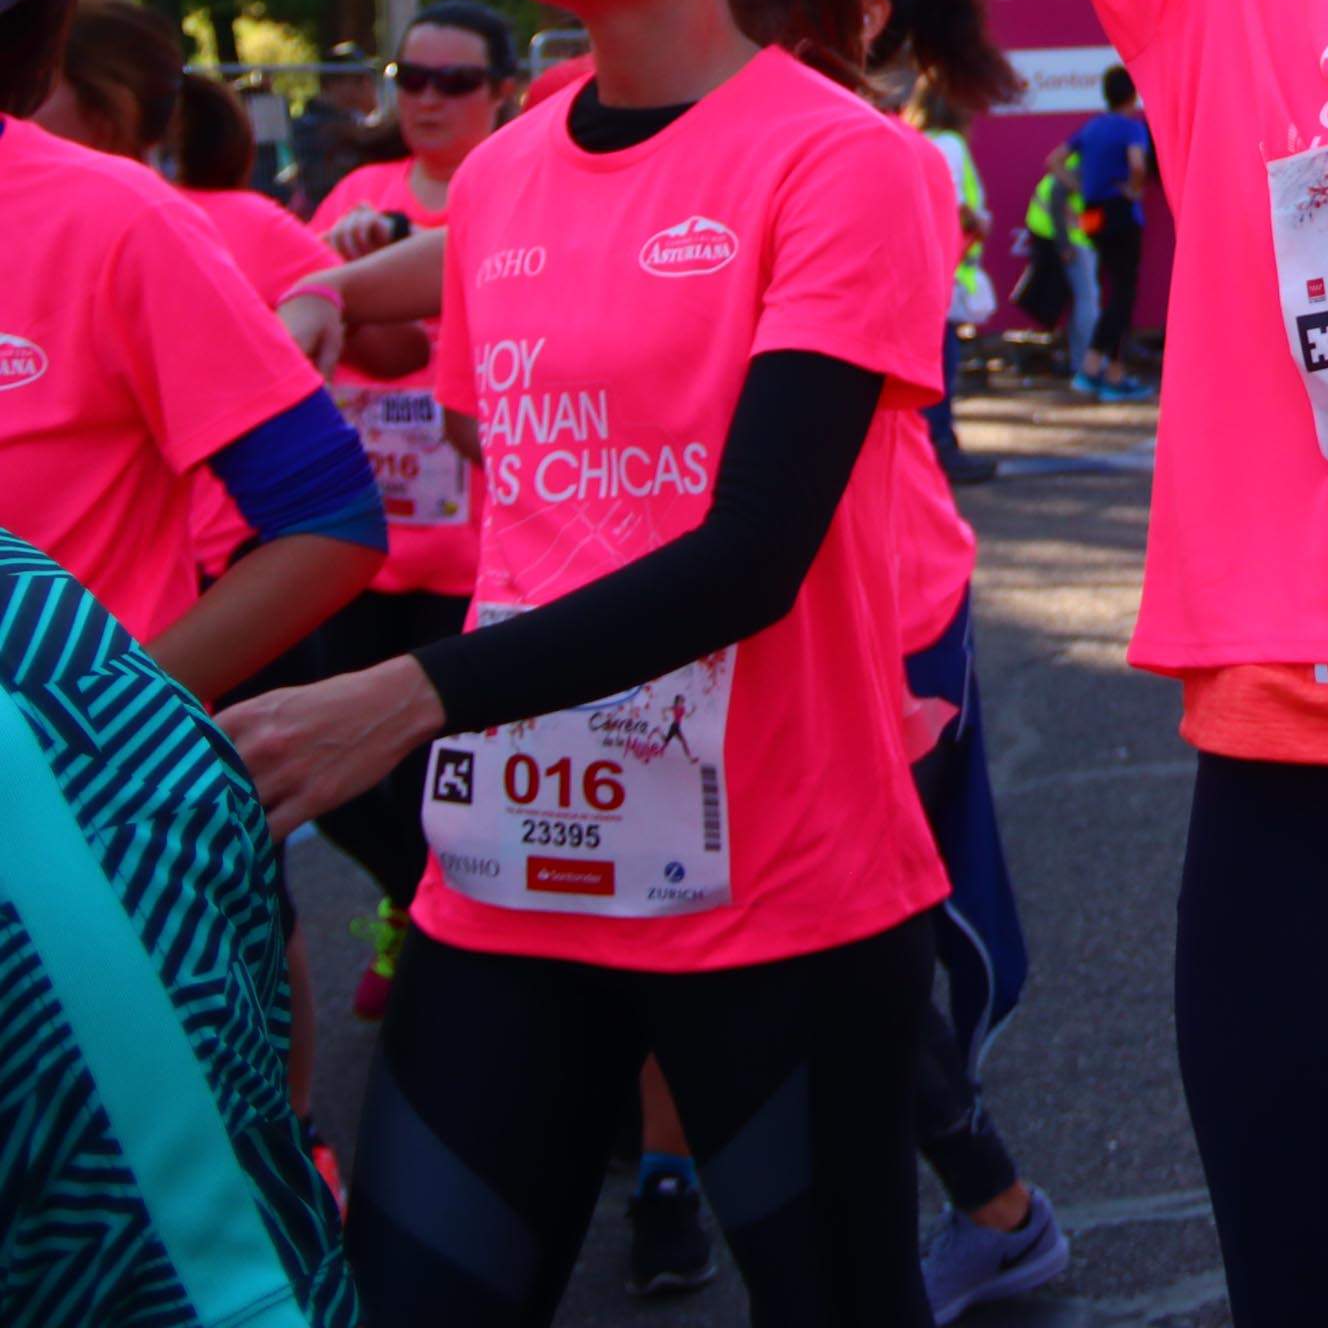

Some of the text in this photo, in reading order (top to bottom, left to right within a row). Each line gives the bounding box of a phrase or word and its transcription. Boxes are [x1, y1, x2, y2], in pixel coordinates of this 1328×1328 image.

[648, 242, 730, 266] ASTURIANA
[533, 441, 709, 503] CHICAS
[503, 753, 626, 812] 016
[521, 819, 601, 849] 23395
[549, 869, 603, 885] Santander
[646, 887, 705, 902] ZURICH
